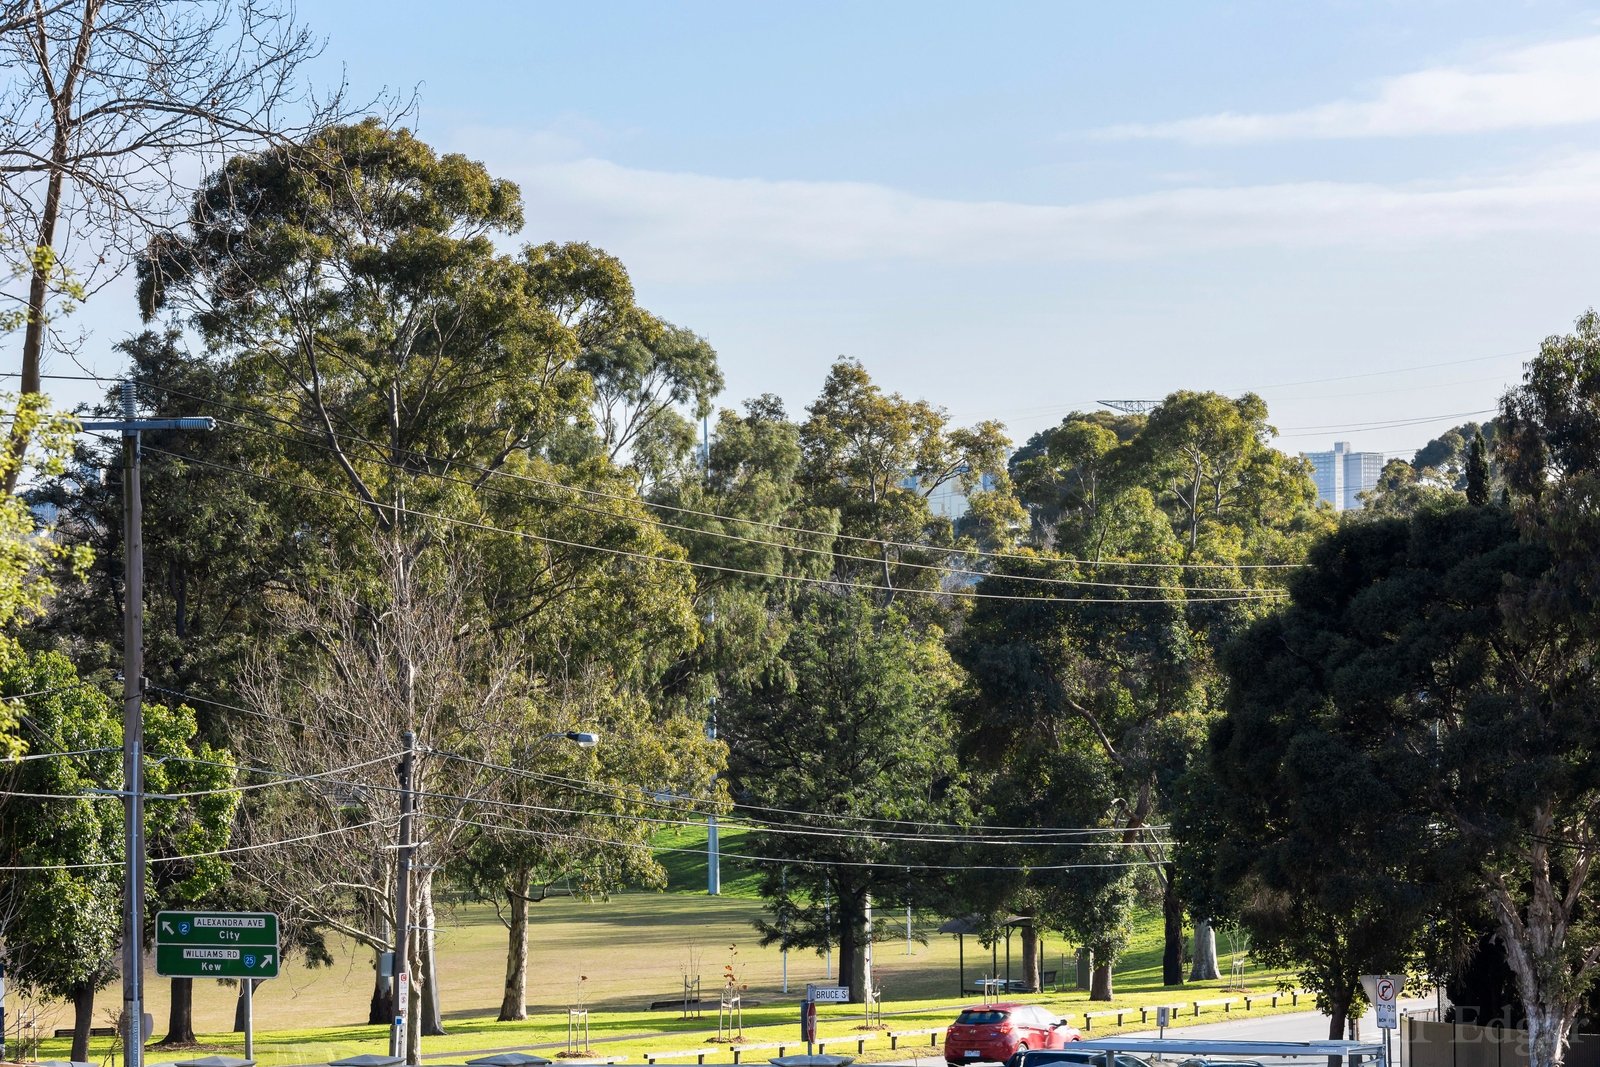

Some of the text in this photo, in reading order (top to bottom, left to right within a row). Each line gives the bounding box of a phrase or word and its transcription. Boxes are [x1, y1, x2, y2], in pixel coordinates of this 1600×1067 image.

[219, 931, 240, 941] City
[201, 962, 222, 971] Kew
[816, 990, 839, 999] BRUCE
